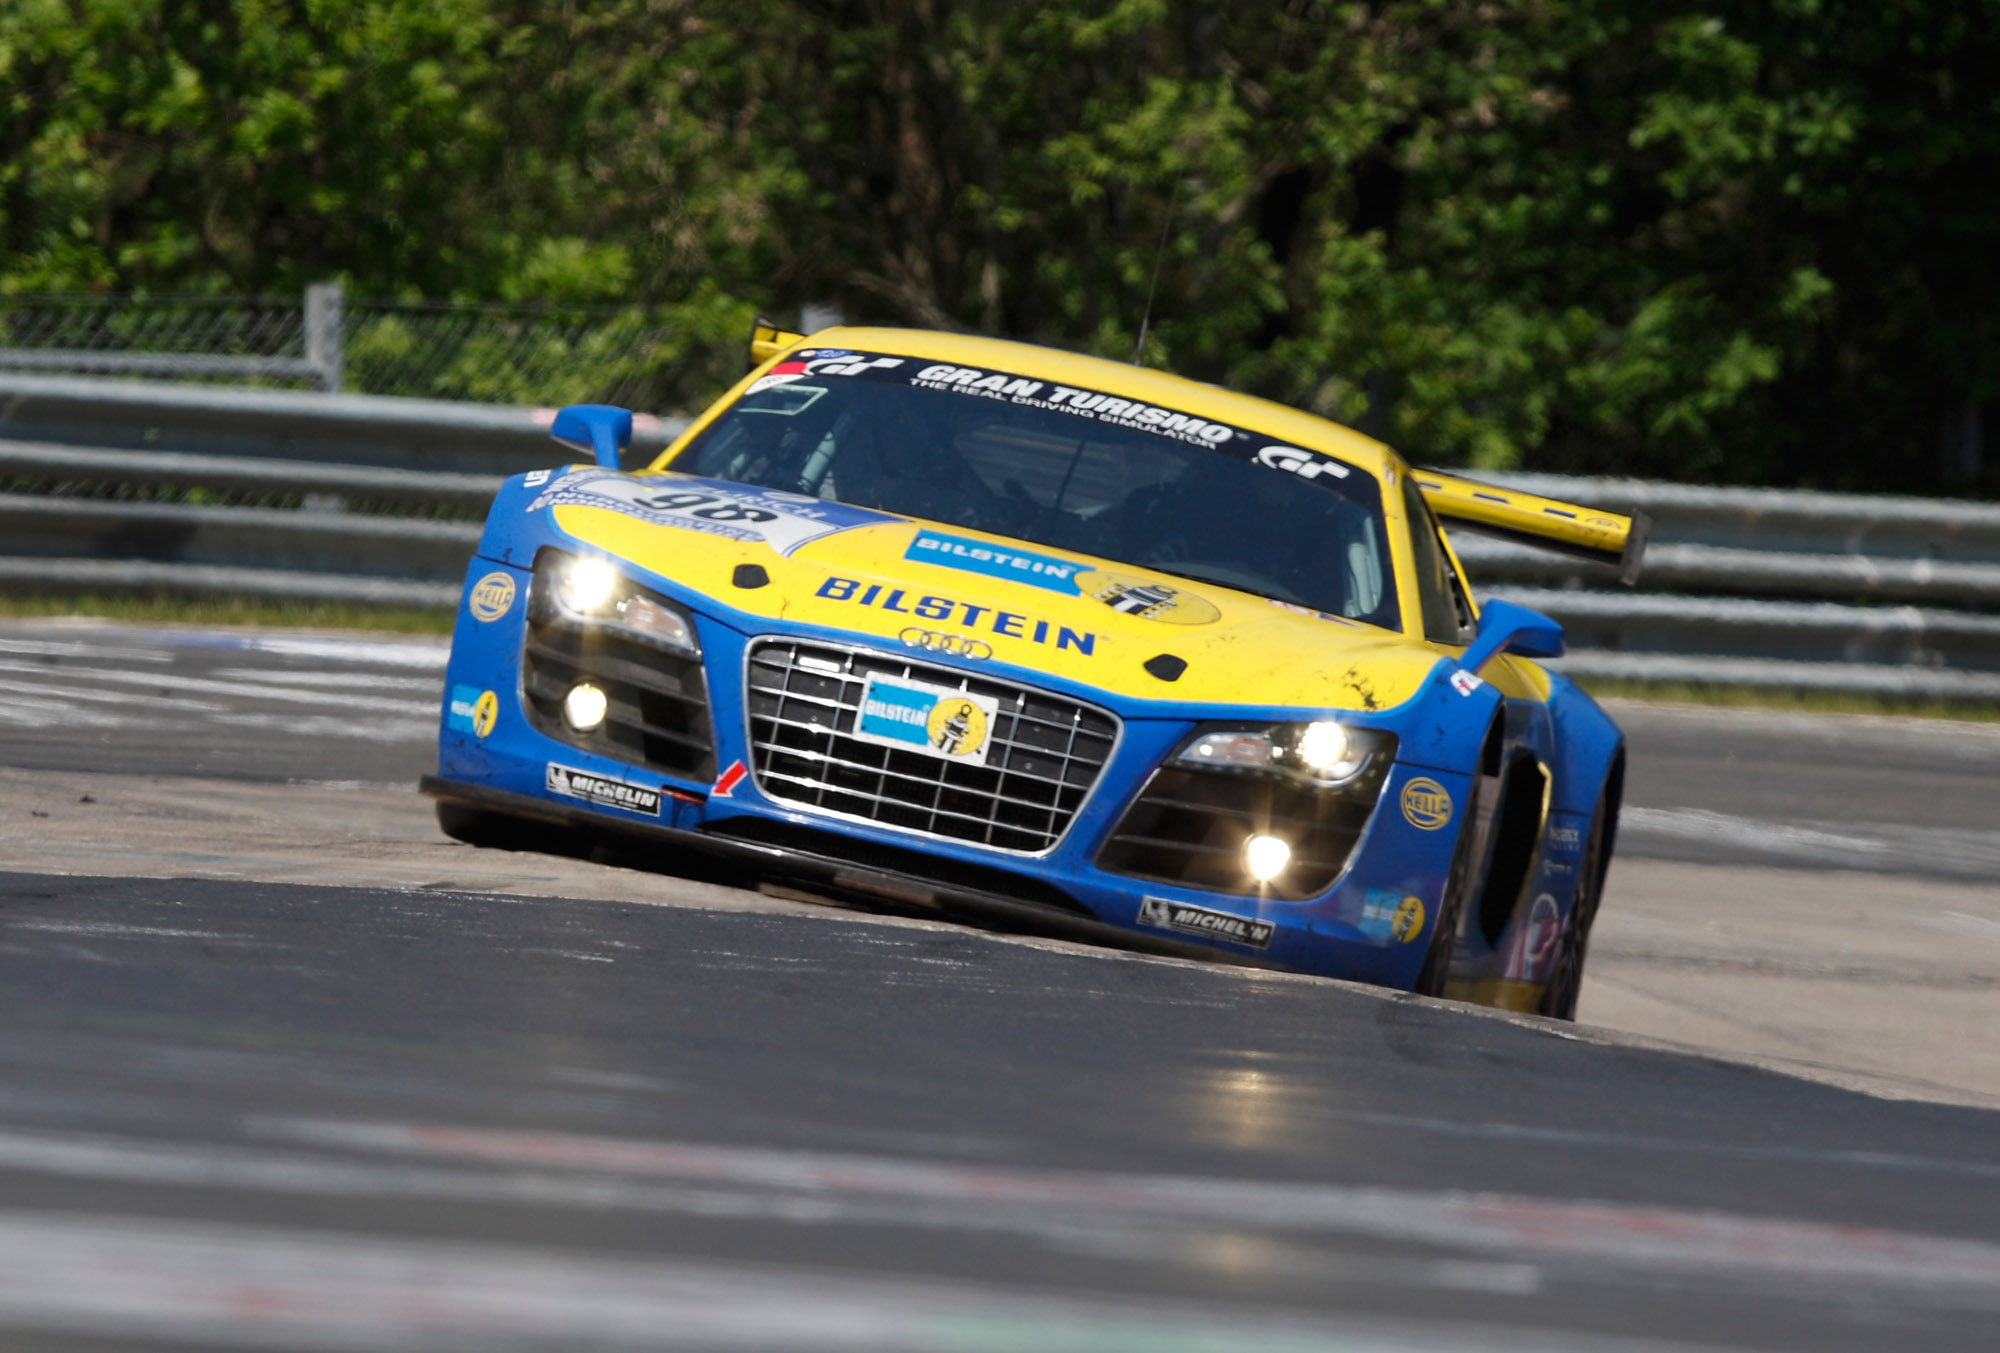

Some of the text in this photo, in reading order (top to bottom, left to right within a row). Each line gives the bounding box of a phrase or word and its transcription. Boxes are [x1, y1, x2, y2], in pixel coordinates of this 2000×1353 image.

[910, 378, 1216, 450] THE REAL DRIVING SIMULATOR
[917, 365, 1233, 443] GRAN TURISMO
[916, 537, 1070, 579] BILSTEIN
[814, 576, 1095, 656] BILSTEIN
[864, 700, 928, 728] BILSTEIN
[571, 775, 657, 807] MICHELIN
[1174, 909, 1268, 941] MICHELN
